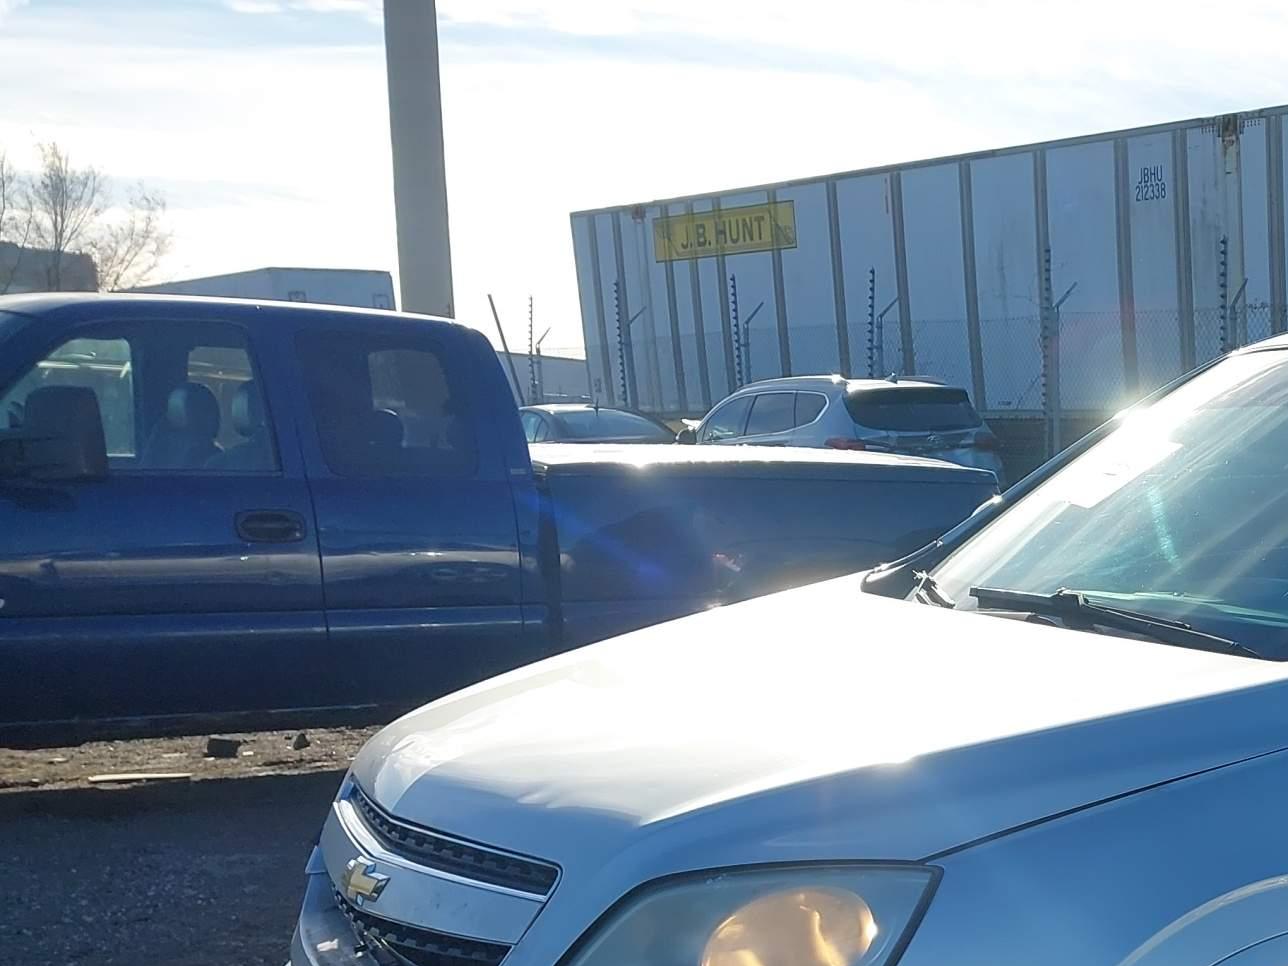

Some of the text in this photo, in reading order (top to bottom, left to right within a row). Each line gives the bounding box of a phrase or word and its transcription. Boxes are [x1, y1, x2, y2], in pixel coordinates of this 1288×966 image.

[1138, 165, 1163, 185] JBHU
[1135, 183, 1167, 202] 212338
[715, 216, 765, 245] HUNT
